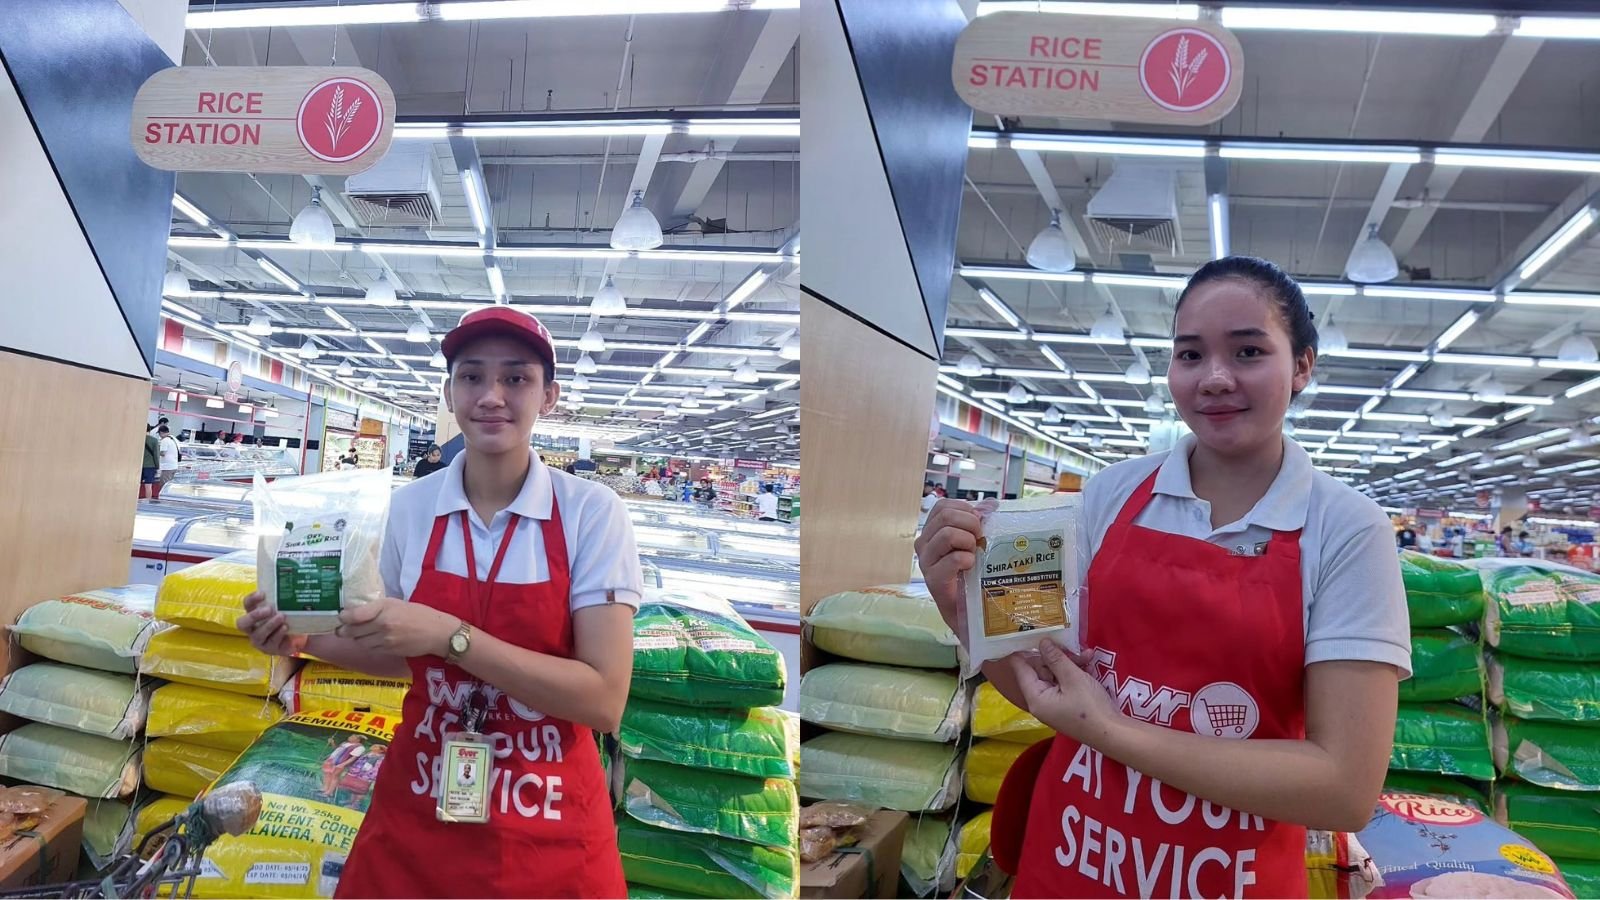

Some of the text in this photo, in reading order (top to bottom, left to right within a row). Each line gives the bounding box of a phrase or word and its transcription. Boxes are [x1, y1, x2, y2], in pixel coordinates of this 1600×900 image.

[1029, 36, 1103, 60] RICE
[969, 64, 1099, 92] STATION
[197, 92, 264, 114] RICE
[144, 122, 261, 145] STATION
[986, 552, 1056, 574] SHIRATAKI RICE
[1027, 573, 1059, 582] SUBSTITUTE
[376, 679, 396, 687] DOUBLE
[365, 726, 395, 740] RIC
[488, 725, 563, 763] OUR
[267, 801, 288, 811] Net
[1394, 800, 1472, 818] Rice
[287, 814, 314, 828] ENT.
[1380, 859, 1475, 875] Finest Quality
